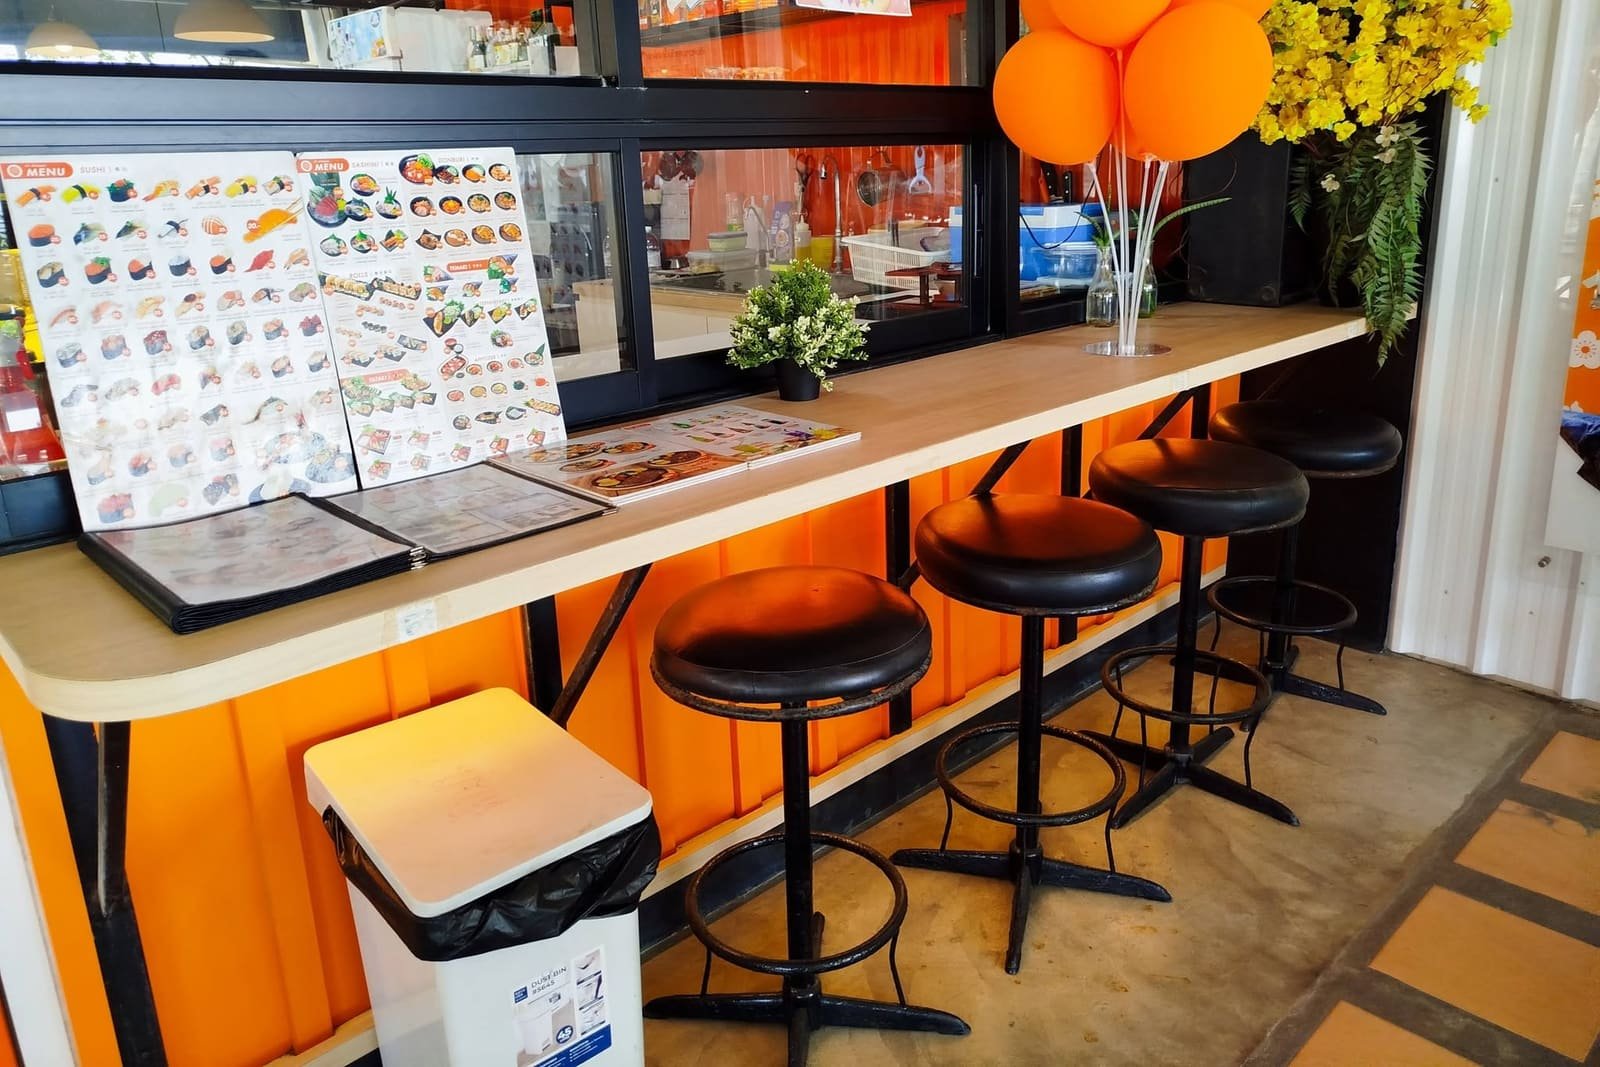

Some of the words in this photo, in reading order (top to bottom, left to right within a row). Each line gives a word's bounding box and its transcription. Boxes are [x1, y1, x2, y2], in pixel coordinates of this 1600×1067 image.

[80, 166, 106, 174] SUSHI
[314, 162, 344, 171] MENU
[26, 167, 65, 177] MENU
[531, 974, 551, 988] DUST
[553, 966, 567, 977] BIN
